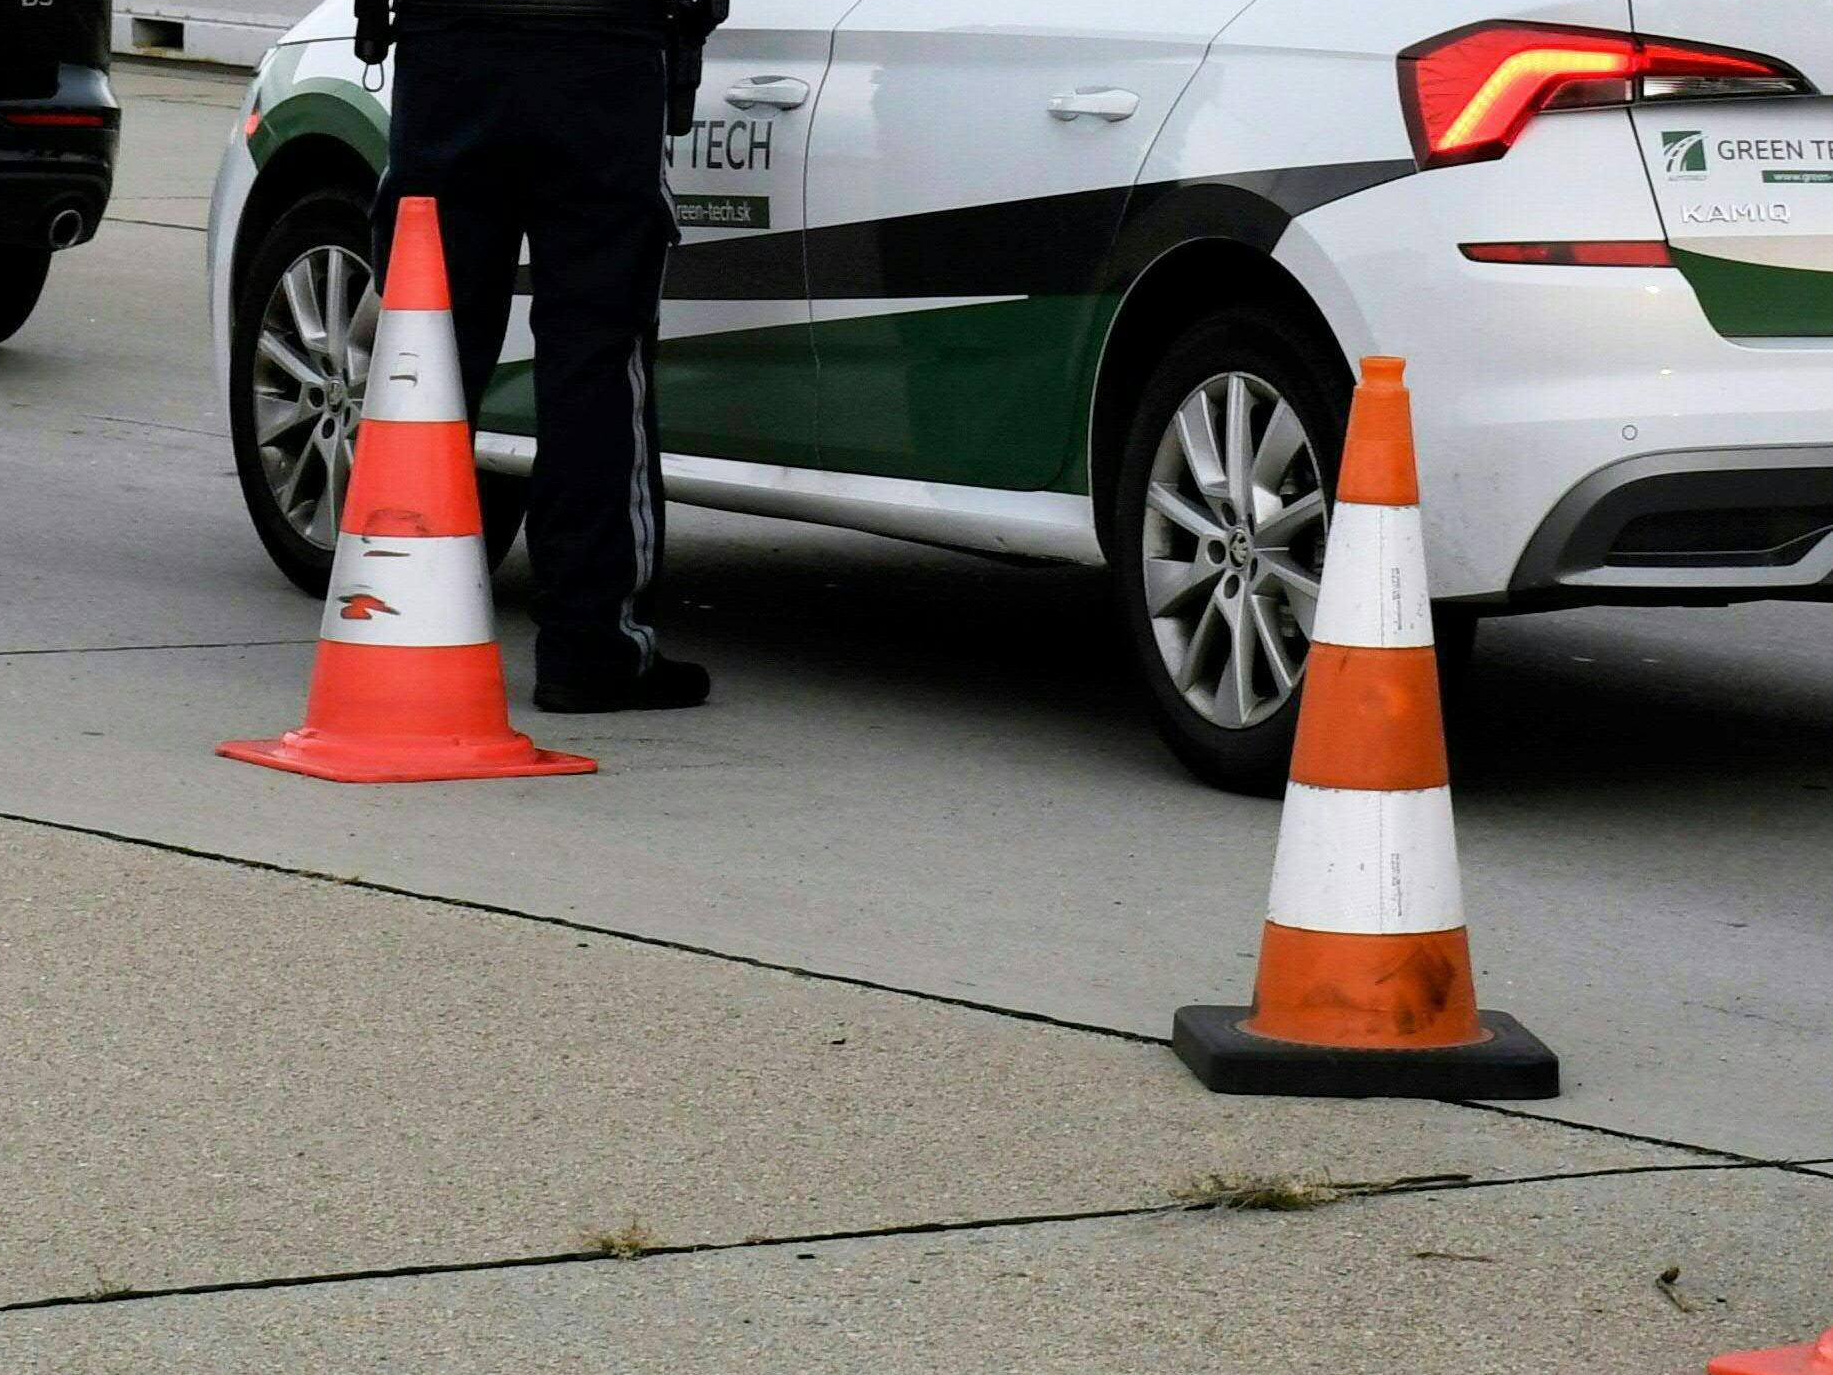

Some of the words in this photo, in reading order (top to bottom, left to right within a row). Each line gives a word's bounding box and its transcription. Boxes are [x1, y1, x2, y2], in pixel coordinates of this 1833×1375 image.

[692, 120, 773, 170] TECH
[1717, 140, 1804, 160] GREEN
[676, 199, 752, 222] reen-tech.sk
[1681, 202, 1792, 224] KAMIQ
